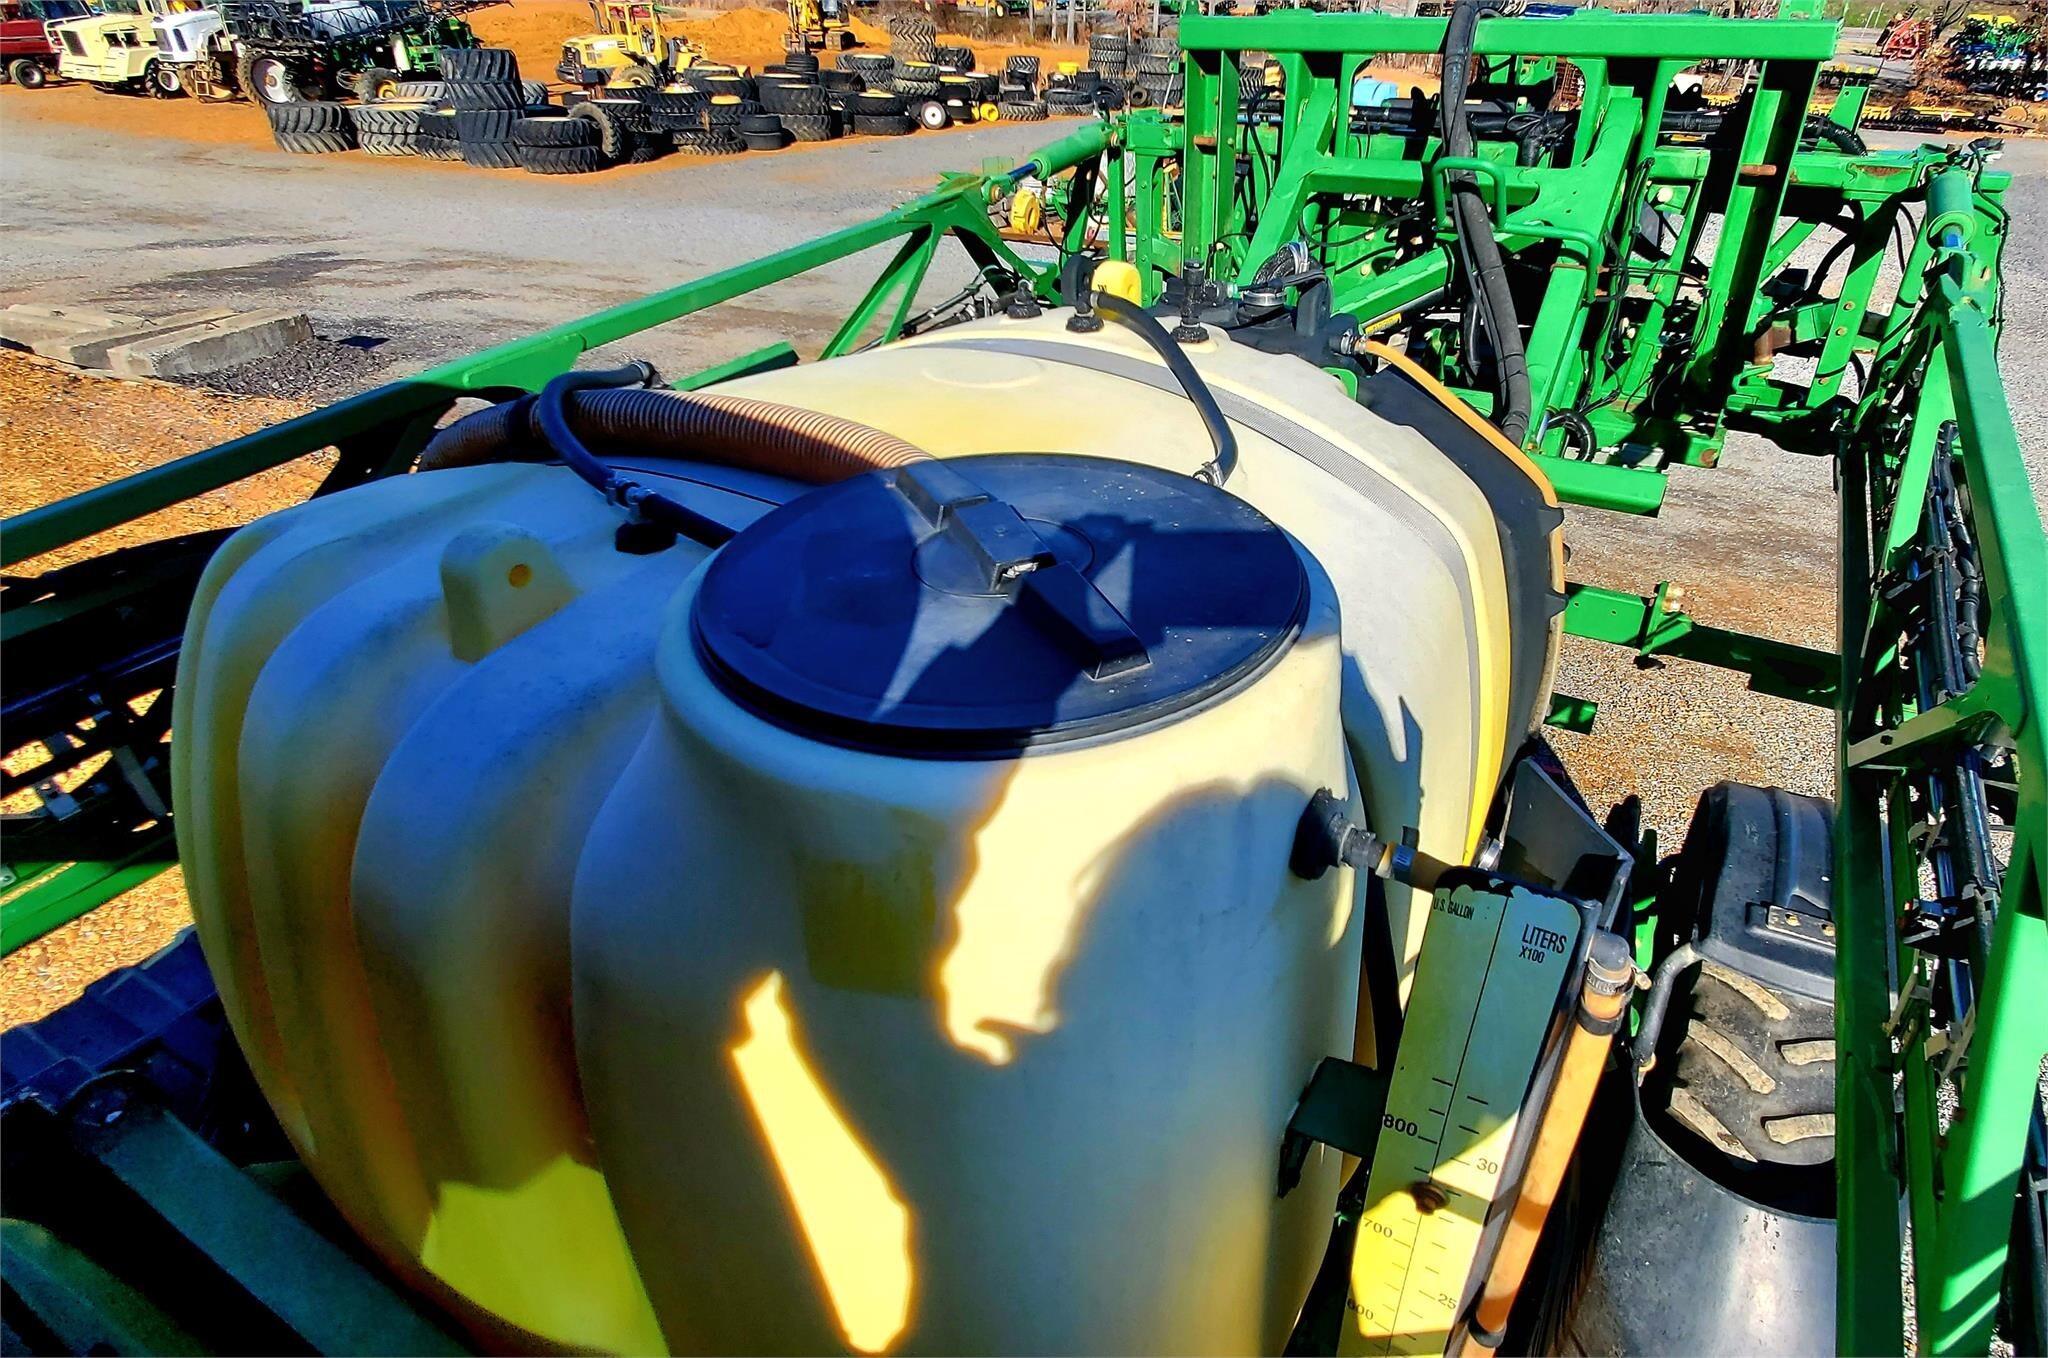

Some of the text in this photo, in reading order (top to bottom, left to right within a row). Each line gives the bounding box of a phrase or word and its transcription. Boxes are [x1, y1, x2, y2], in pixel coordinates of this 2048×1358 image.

[1447, 901, 1475, 921] GALLON
[1521, 923, 1567, 954] LITERS
[1518, 945, 1545, 964] X100
[1383, 1113, 1418, 1137] 800
[1476, 1157, 1498, 1175] 30
[1363, 1217, 1393, 1239] 700
[1347, 1298, 1374, 1321] 600
[1438, 1293, 1457, 1310] 25
